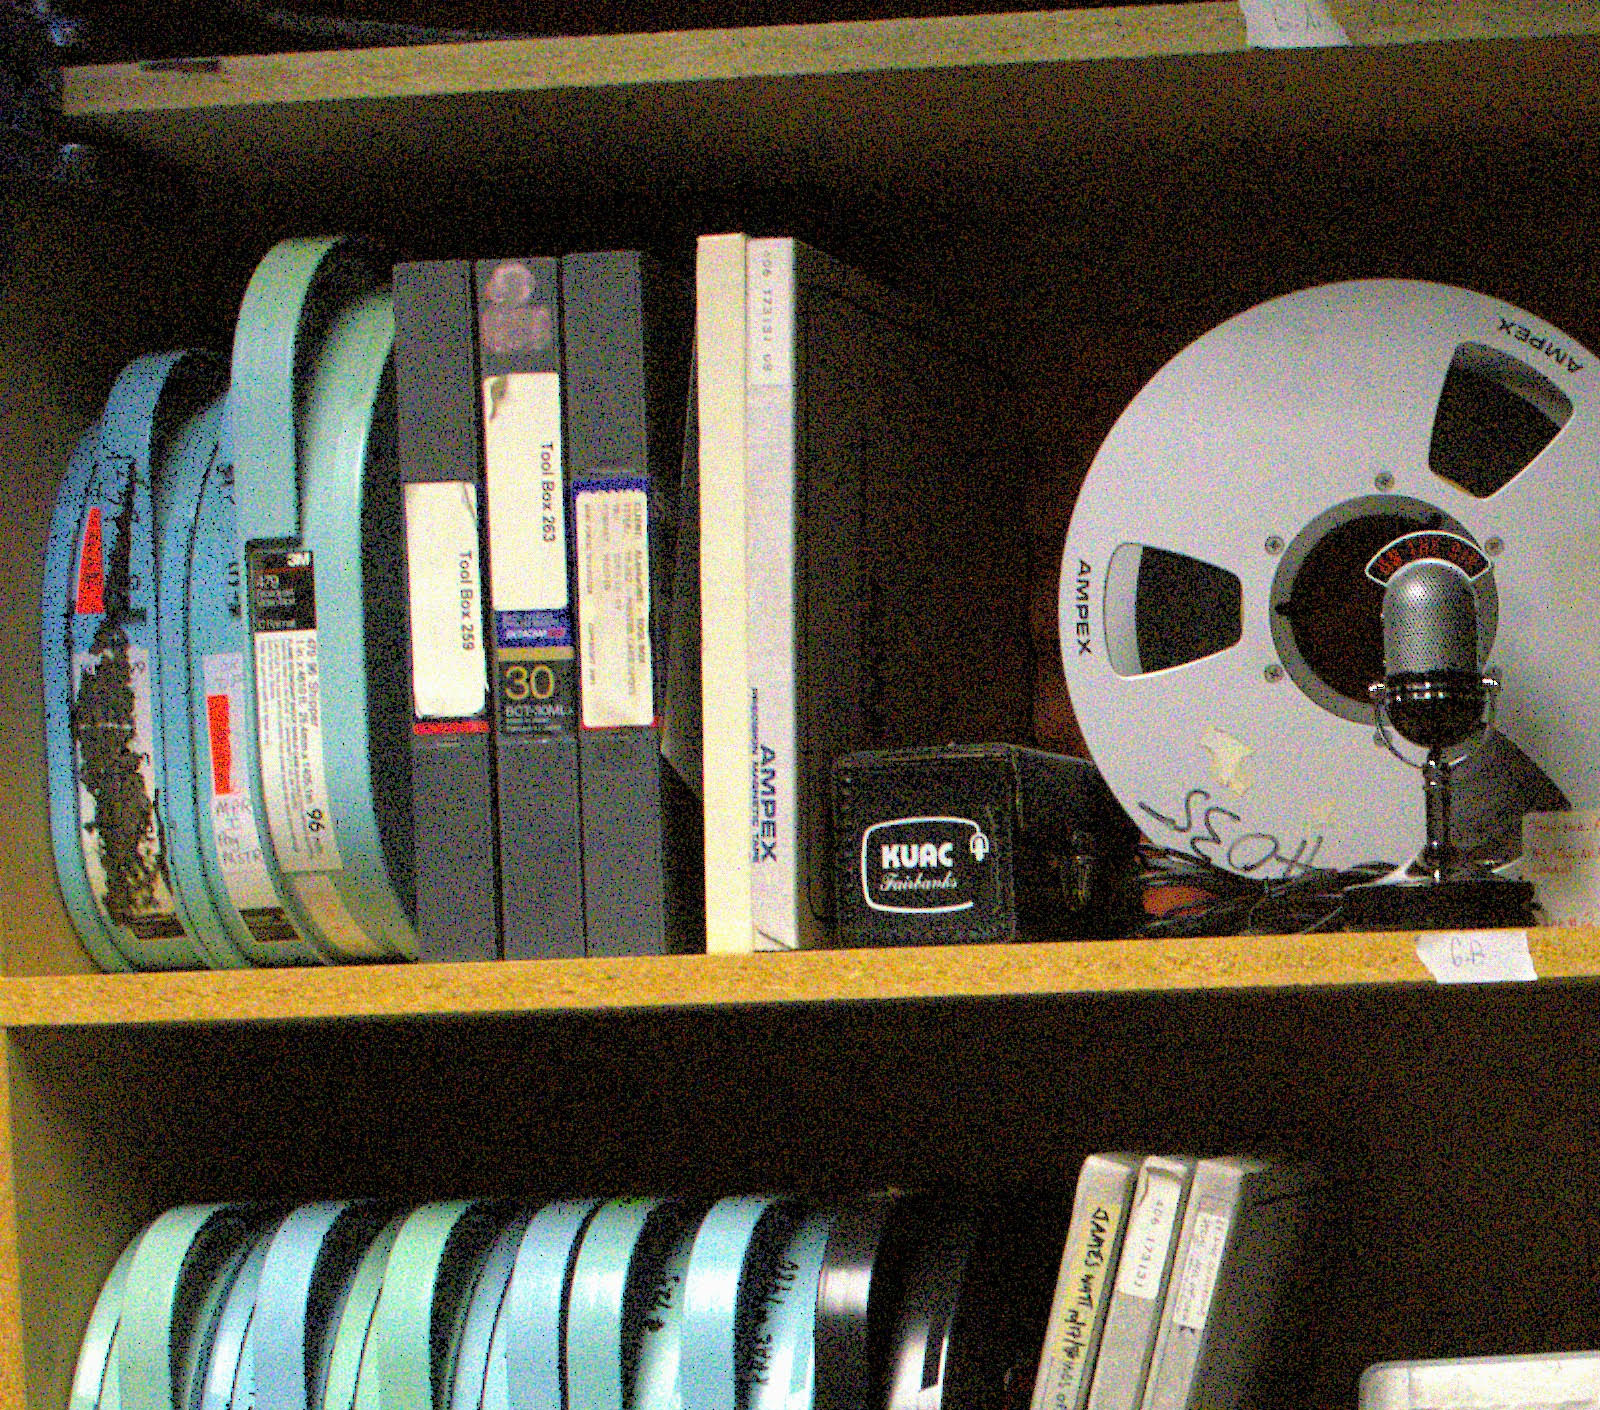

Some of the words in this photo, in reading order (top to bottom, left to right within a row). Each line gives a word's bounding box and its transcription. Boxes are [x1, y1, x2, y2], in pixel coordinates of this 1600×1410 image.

[1499, 316, 1585, 375] AMPEX
[540, 442, 554, 476] Tool
[541, 480, 554, 509] Box
[541, 513, 555, 542] 263
[458, 549, 473, 584] Tool
[460, 588, 474, 617] Box
[1076, 559, 1092, 656] AMPEX
[461, 622, 475, 651] 259
[505, 667, 553, 700] 30
[751, 686, 760, 755] PRECISION
[751, 761, 760, 827] MAGNETIC
[761, 744, 777, 863] AMPEX
[305, 807, 323, 833] 96
[751, 834, 760, 864] TAPE
[881, 843, 954, 869] KUAC
[878, 871, 958, 892] Fairbanks
[1084, 1207, 1110, 1269] JAMES
